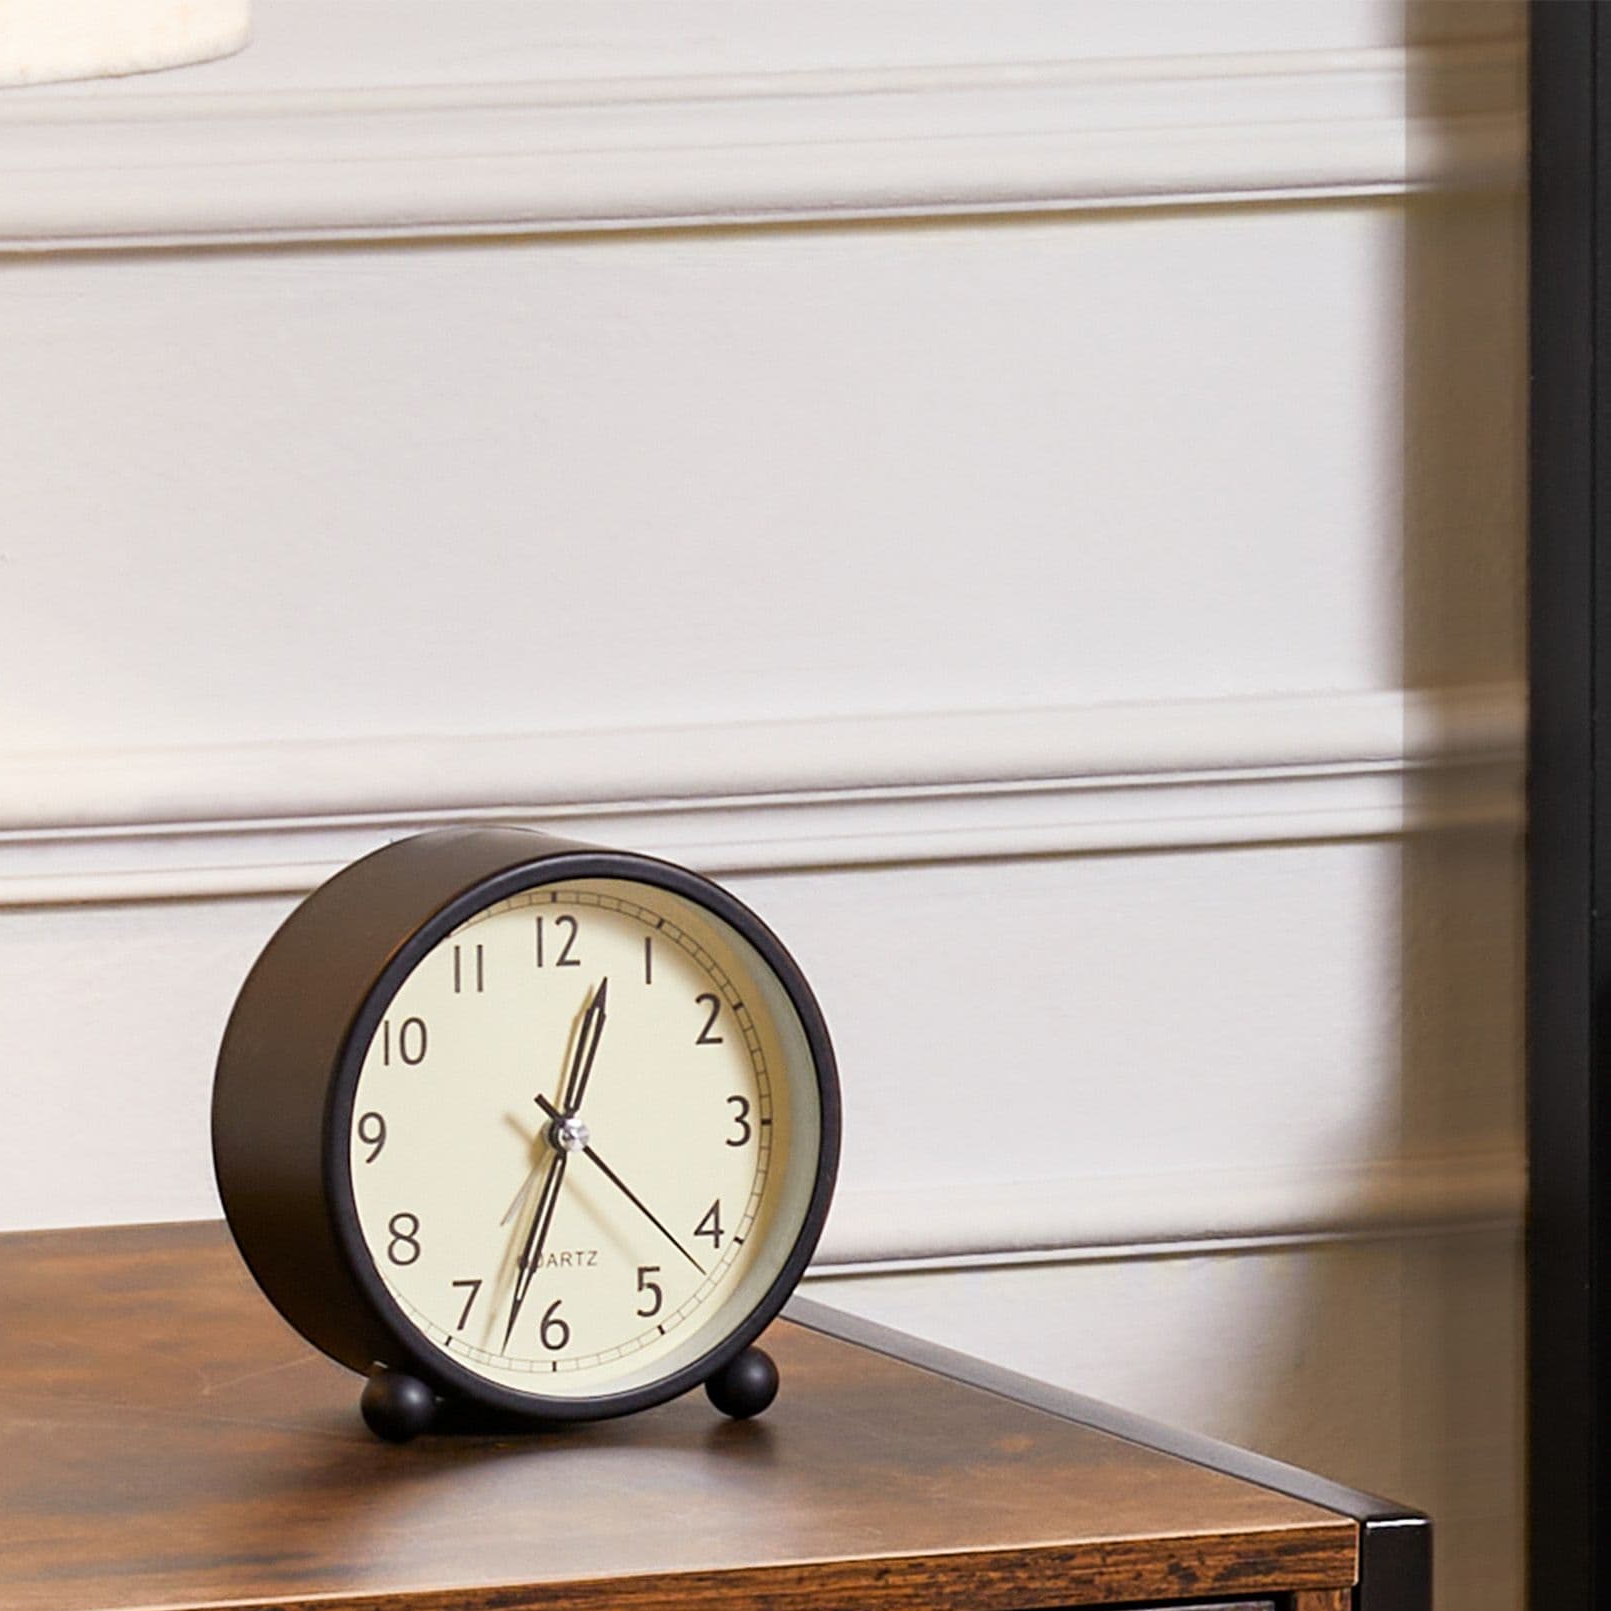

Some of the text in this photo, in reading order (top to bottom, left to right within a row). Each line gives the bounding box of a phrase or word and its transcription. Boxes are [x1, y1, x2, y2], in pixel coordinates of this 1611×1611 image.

[536, 915, 581, 968] 12
[644, 936, 652, 985] 1
[454, 944, 483, 993] 11
[382, 1017, 428, 1066] 10
[694, 993, 724, 1045] 2
[358, 1112, 387, 1164] 9
[725, 1095, 751, 1147] 3
[387, 1212, 421, 1266] 8
[693, 1199, 725, 1249] 4
[519, 1250, 598, 1270] UARTZ
[452, 1279, 482, 1332] 7
[637, 1266, 663, 1318] 5
[540, 1300, 570, 1351] 6
